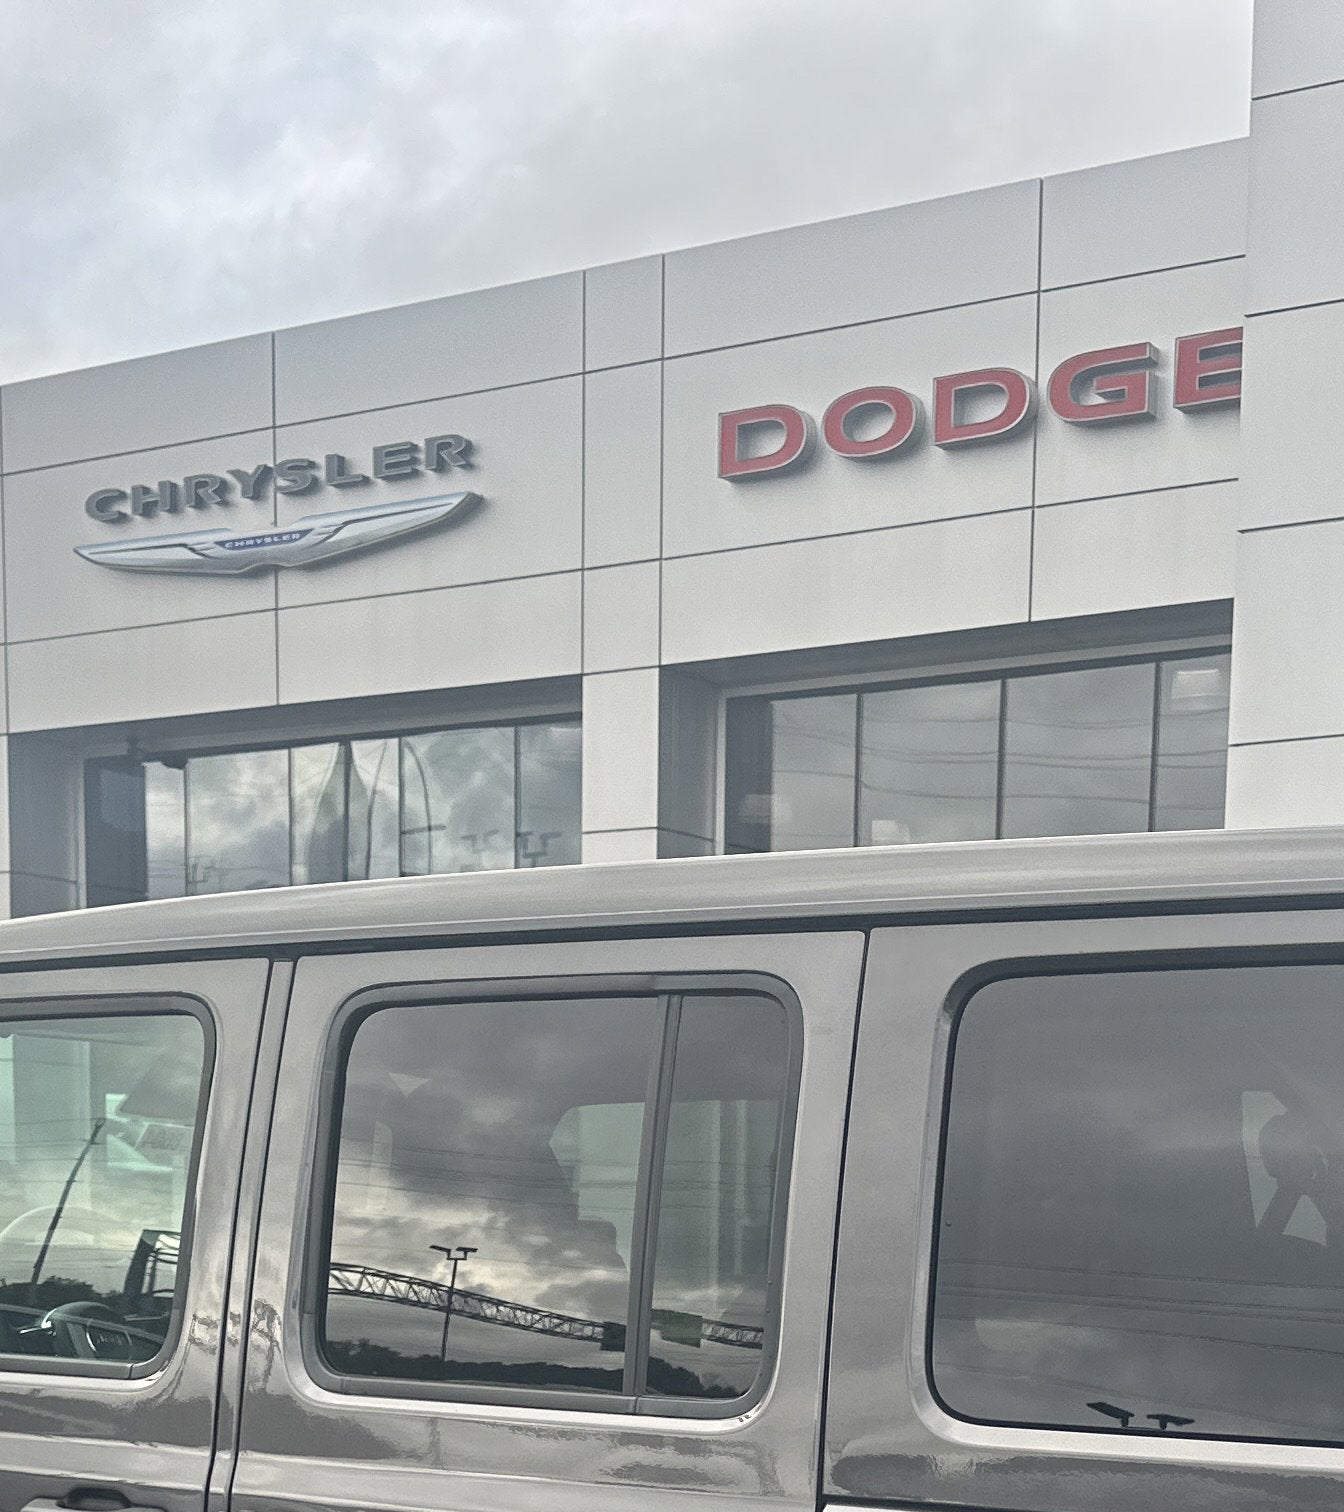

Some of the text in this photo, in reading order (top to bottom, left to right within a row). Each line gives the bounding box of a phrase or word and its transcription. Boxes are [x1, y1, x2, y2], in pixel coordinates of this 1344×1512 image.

[718, 326, 1243, 480] DODGE
[85, 434, 476, 523] CHRYSLER
[224, 533, 301, 549] CHRYSLER
